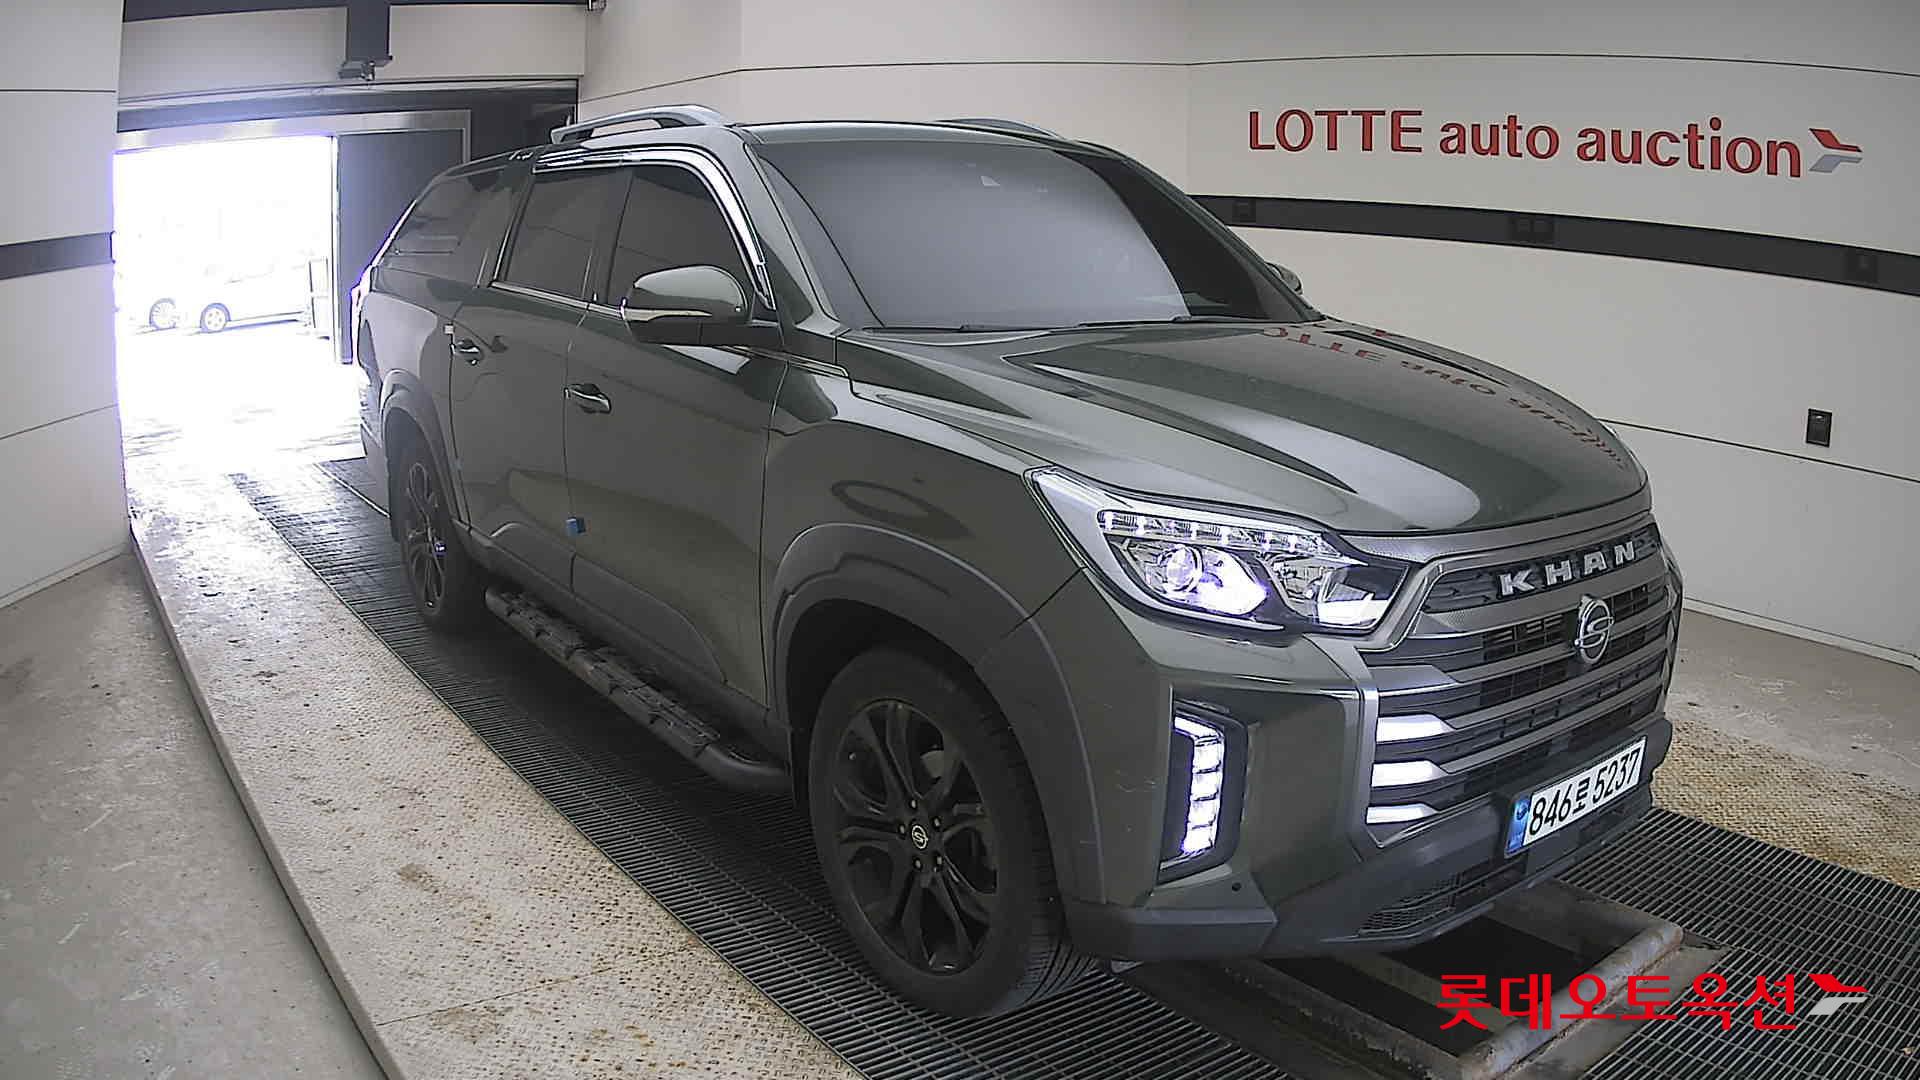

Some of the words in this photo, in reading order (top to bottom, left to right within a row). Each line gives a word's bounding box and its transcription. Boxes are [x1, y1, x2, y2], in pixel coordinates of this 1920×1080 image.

[1249, 110, 1422, 152] LOTTE
[1439, 114, 1559, 160] auto
[1576, 117, 1801, 178] auction
[1499, 540, 1635, 597] KHAN
